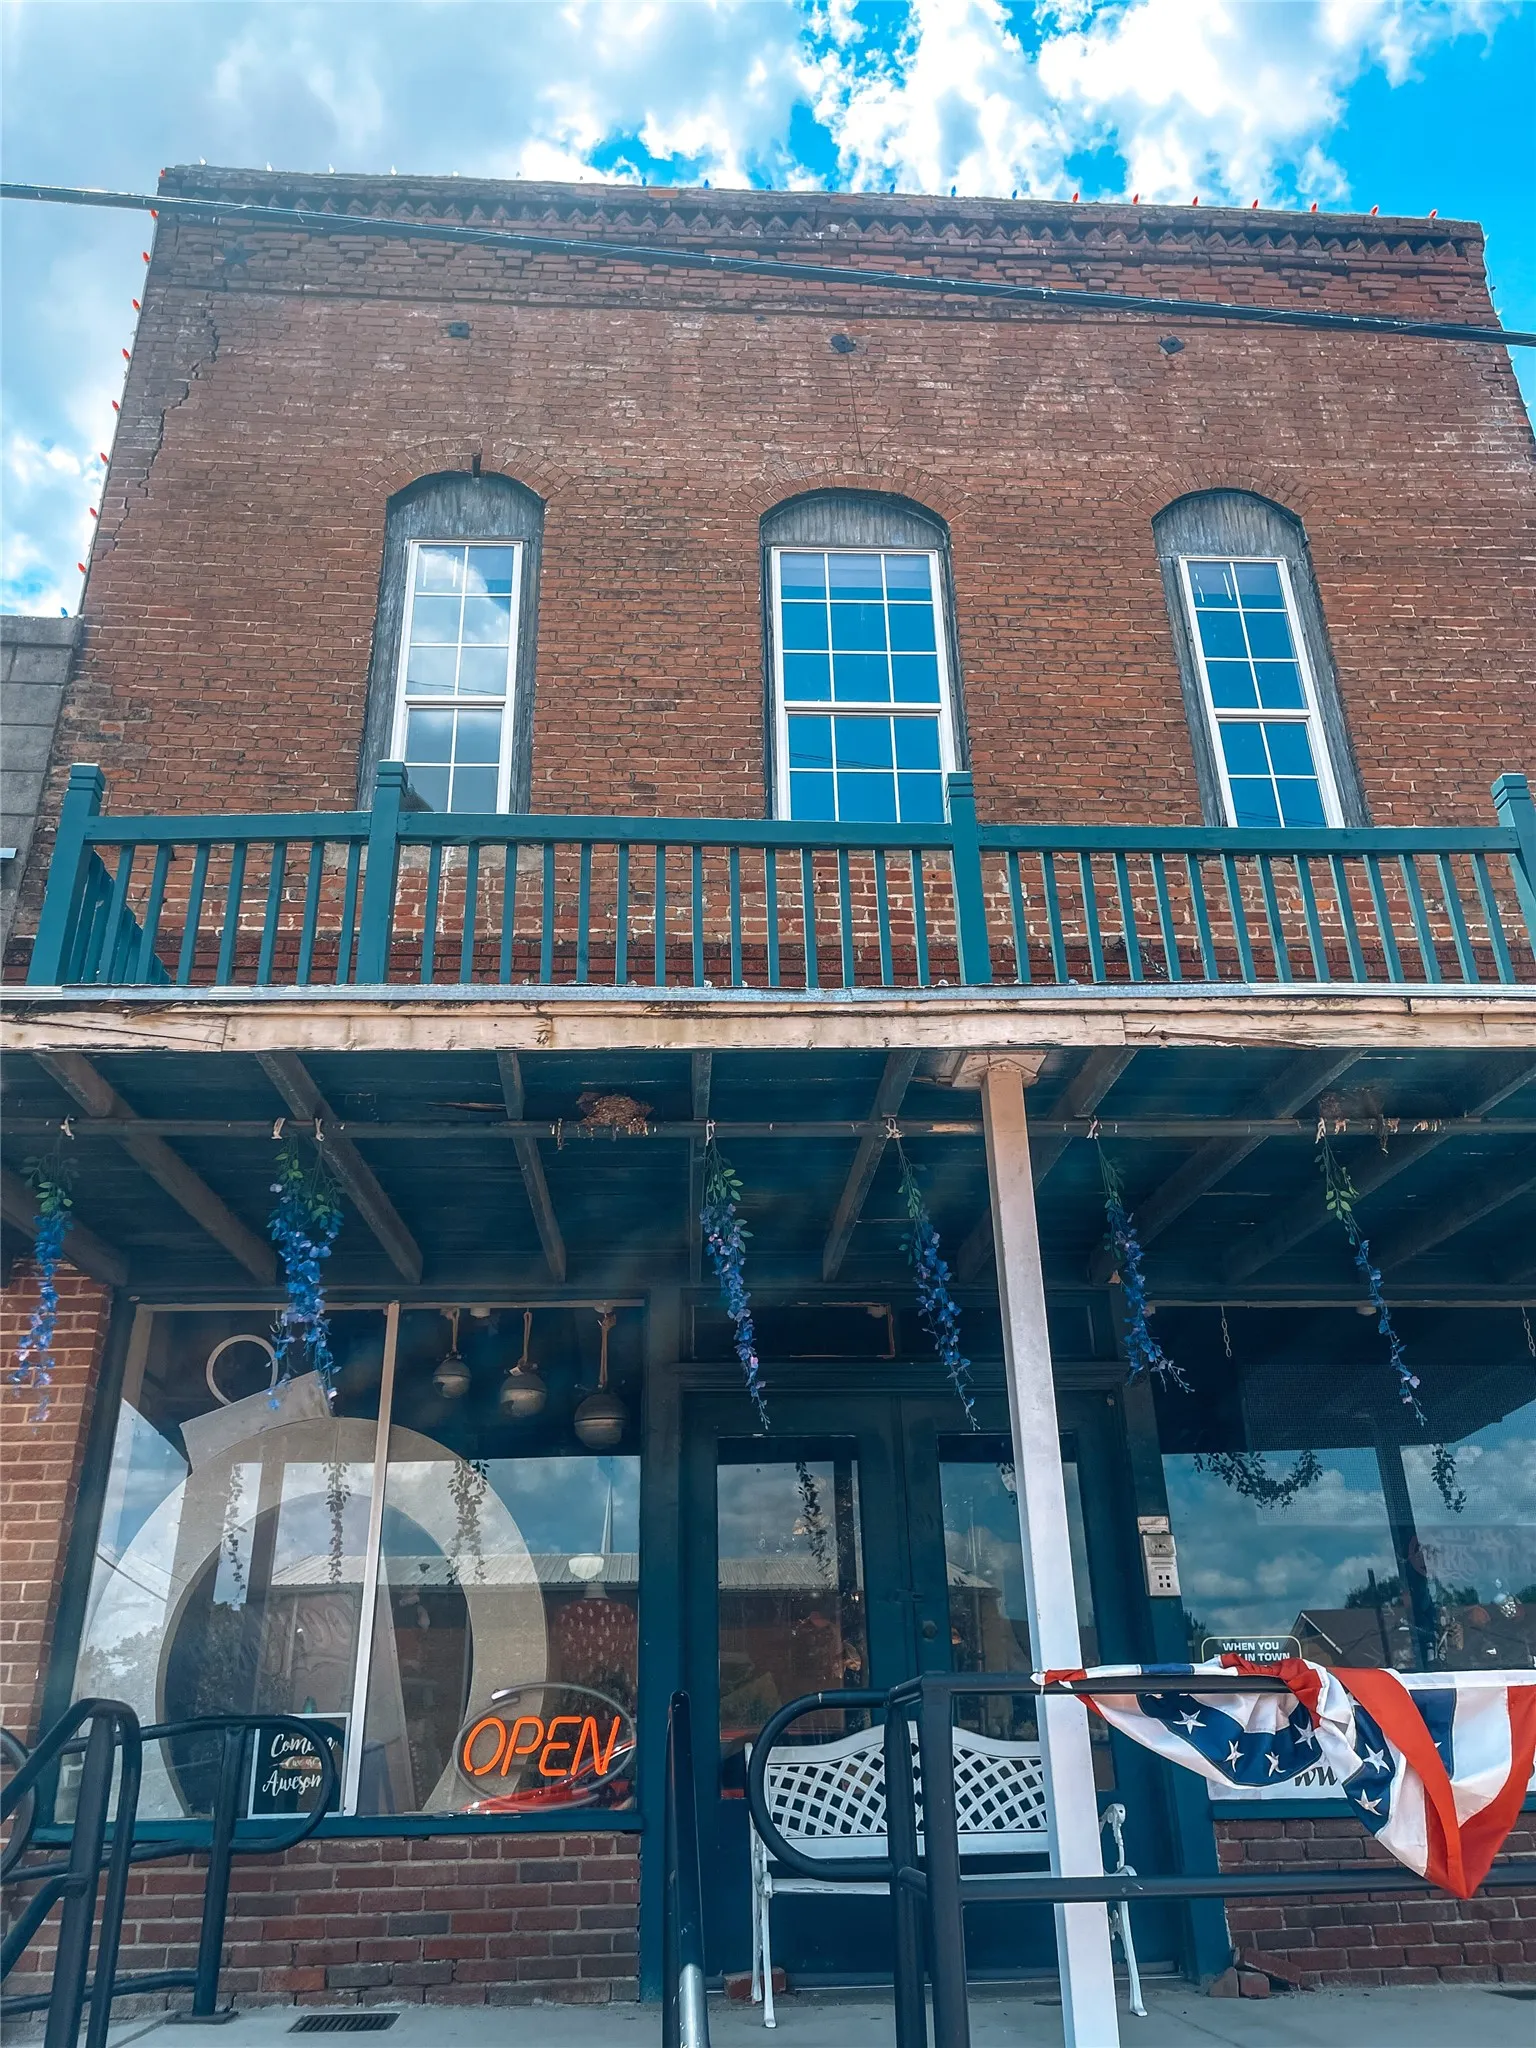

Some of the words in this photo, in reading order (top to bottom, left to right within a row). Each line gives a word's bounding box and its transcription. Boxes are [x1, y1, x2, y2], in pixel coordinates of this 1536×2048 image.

[1222, 1641, 1256, 1651] WHEN
[1257, 1641, 1280, 1651] YOU
[1244, 1652, 1256, 1662] IN
[1257, 1651, 1290, 1662] TOWN
[463, 1715, 621, 1777] OPEN
